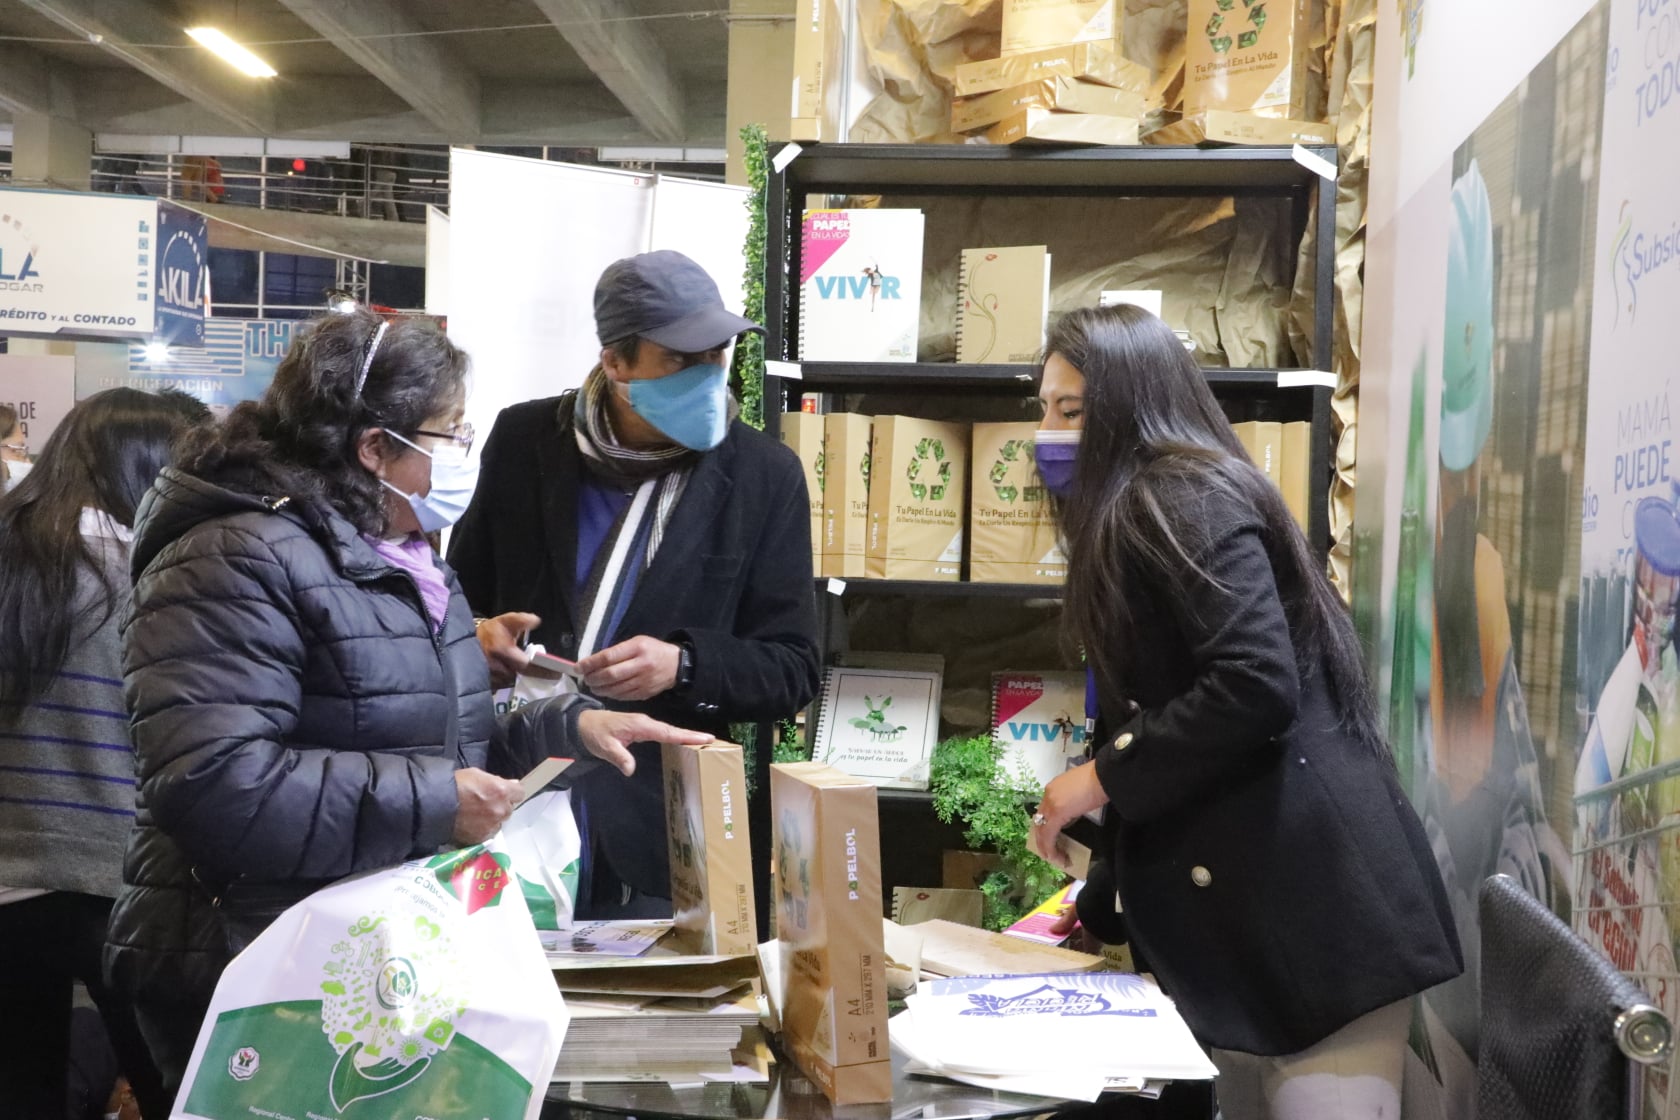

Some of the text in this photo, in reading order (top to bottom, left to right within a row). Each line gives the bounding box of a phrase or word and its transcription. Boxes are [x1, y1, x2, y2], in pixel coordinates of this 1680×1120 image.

[158, 264, 203, 310] AKILA
[73, 314, 137, 326] CONTADO
[243, 321, 294, 358] TH
[20, 402, 36, 419] DE
[1617, 378, 1671, 448] MAMÁ
[1614, 439, 1671, 494] PUEDE
[896, 506, 956, 518] Tu Papel En La Vida
[979, 508, 990, 517] Tu
[992, 509, 1015, 519] Papel
[1017, 509, 1028, 518] En
[727, 920, 739, 935] A4
[862, 955, 871, 967] MM
[863, 989, 873, 1001] MM
[848, 998, 862, 1016] A4
[864, 1002, 874, 1015] 210
